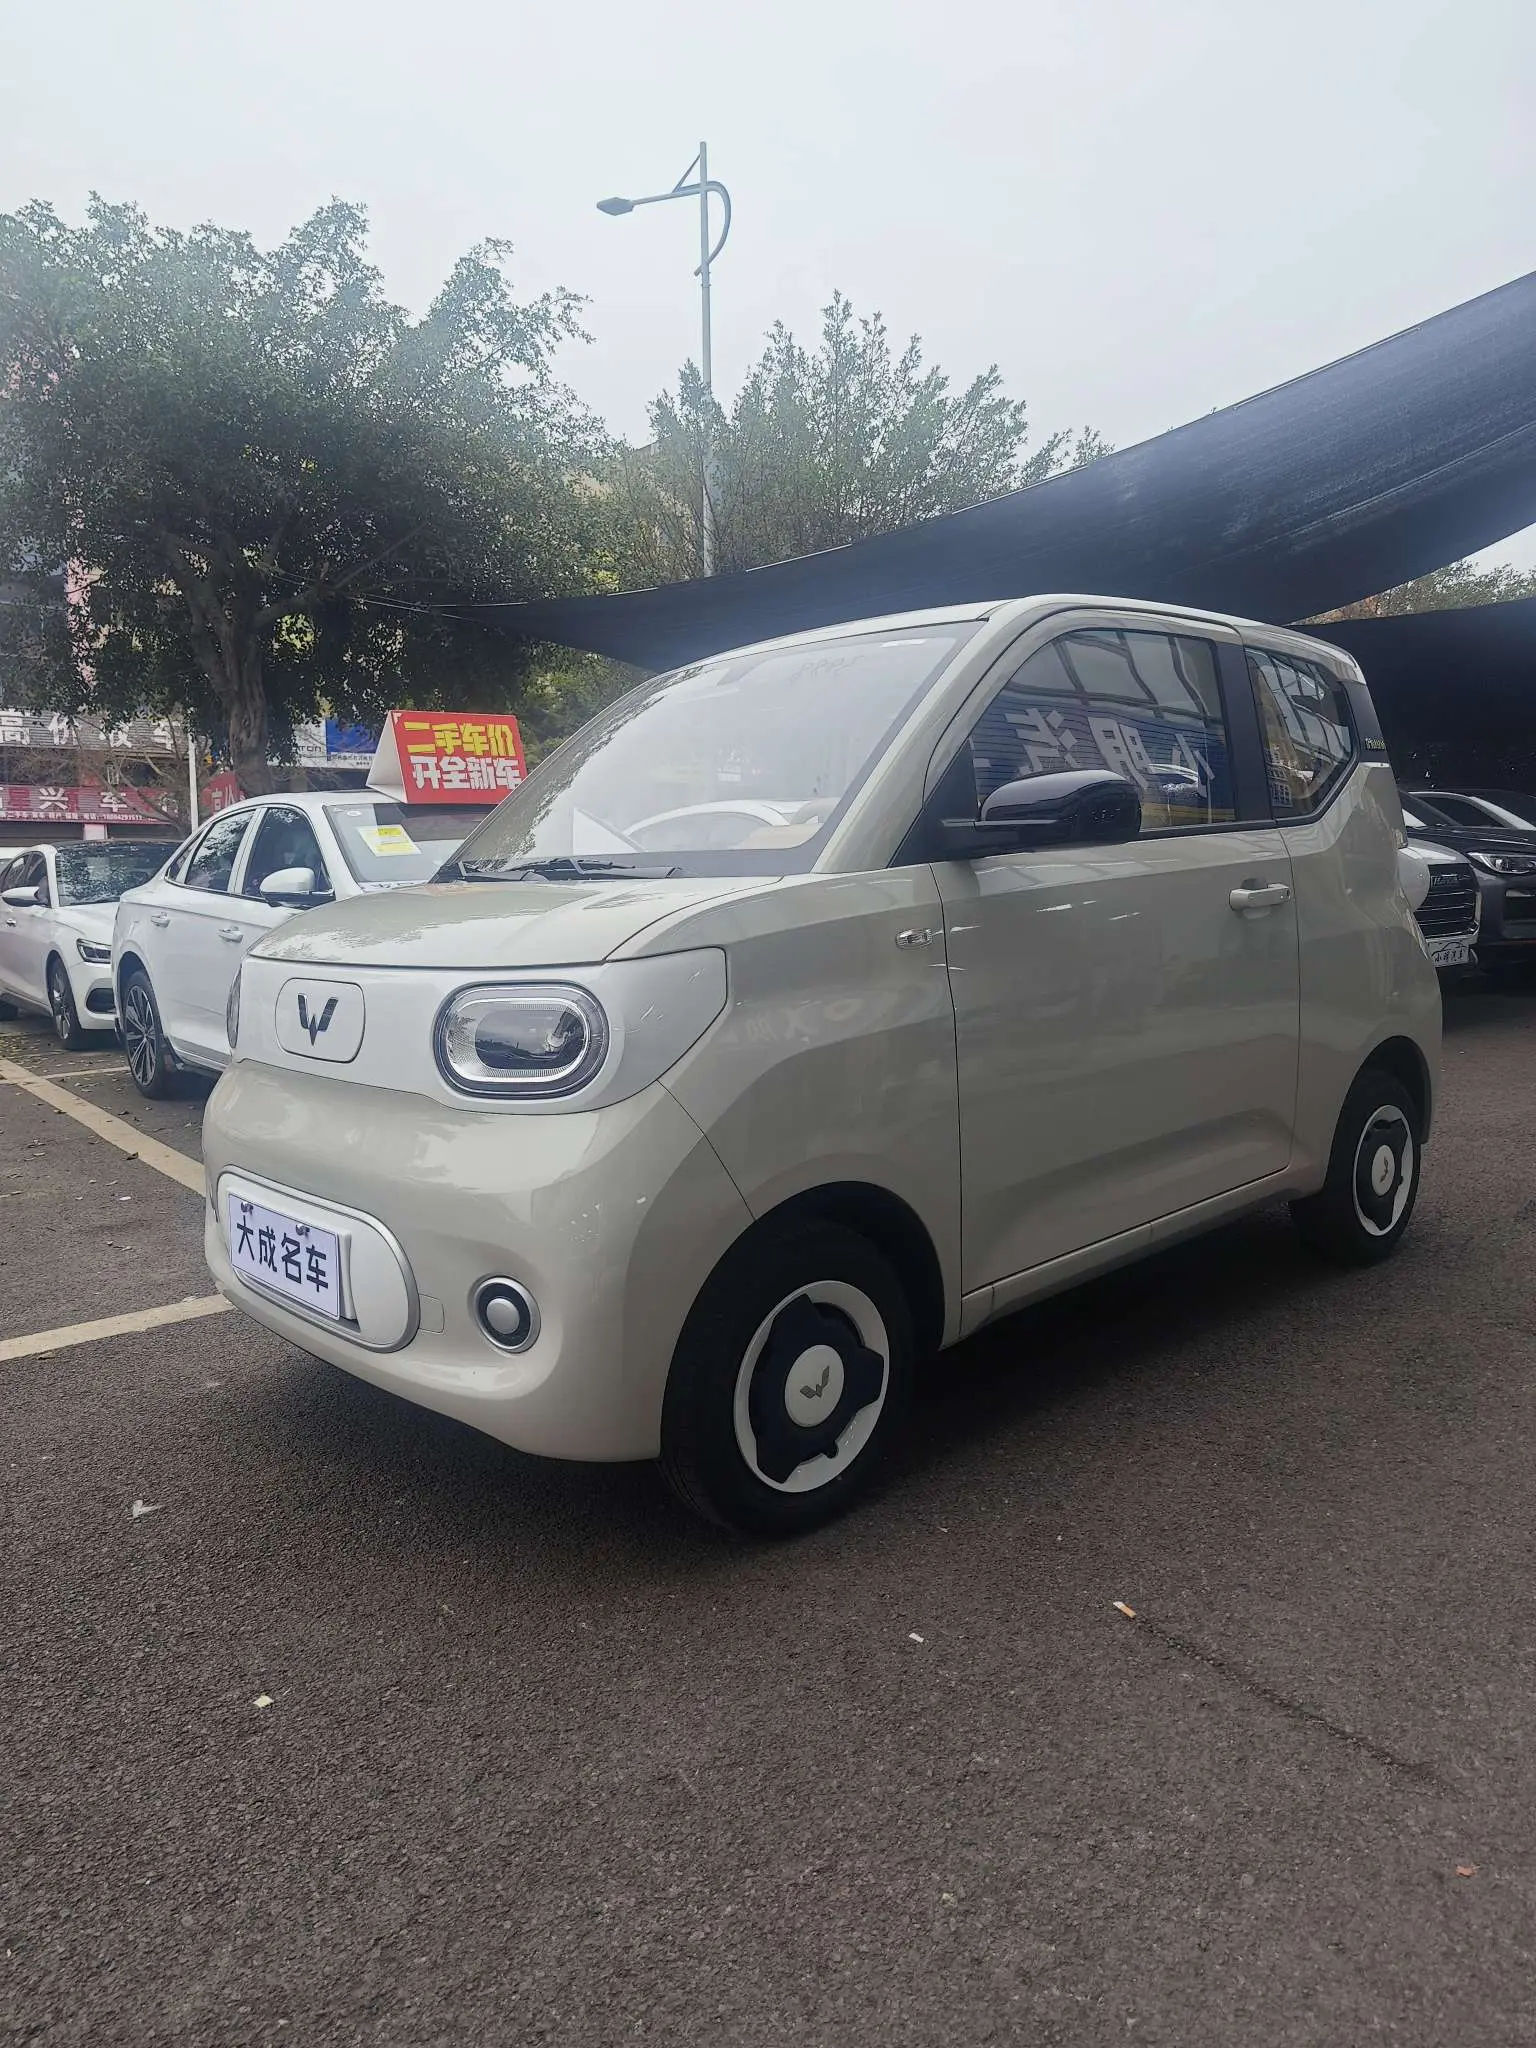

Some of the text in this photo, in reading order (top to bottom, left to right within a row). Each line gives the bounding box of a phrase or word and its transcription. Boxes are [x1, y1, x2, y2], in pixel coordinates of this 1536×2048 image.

[404, 721, 516, 757] 二手车价
[410, 755, 522, 790] 开全新车
[236, 1215, 329, 1293] 大成名车
